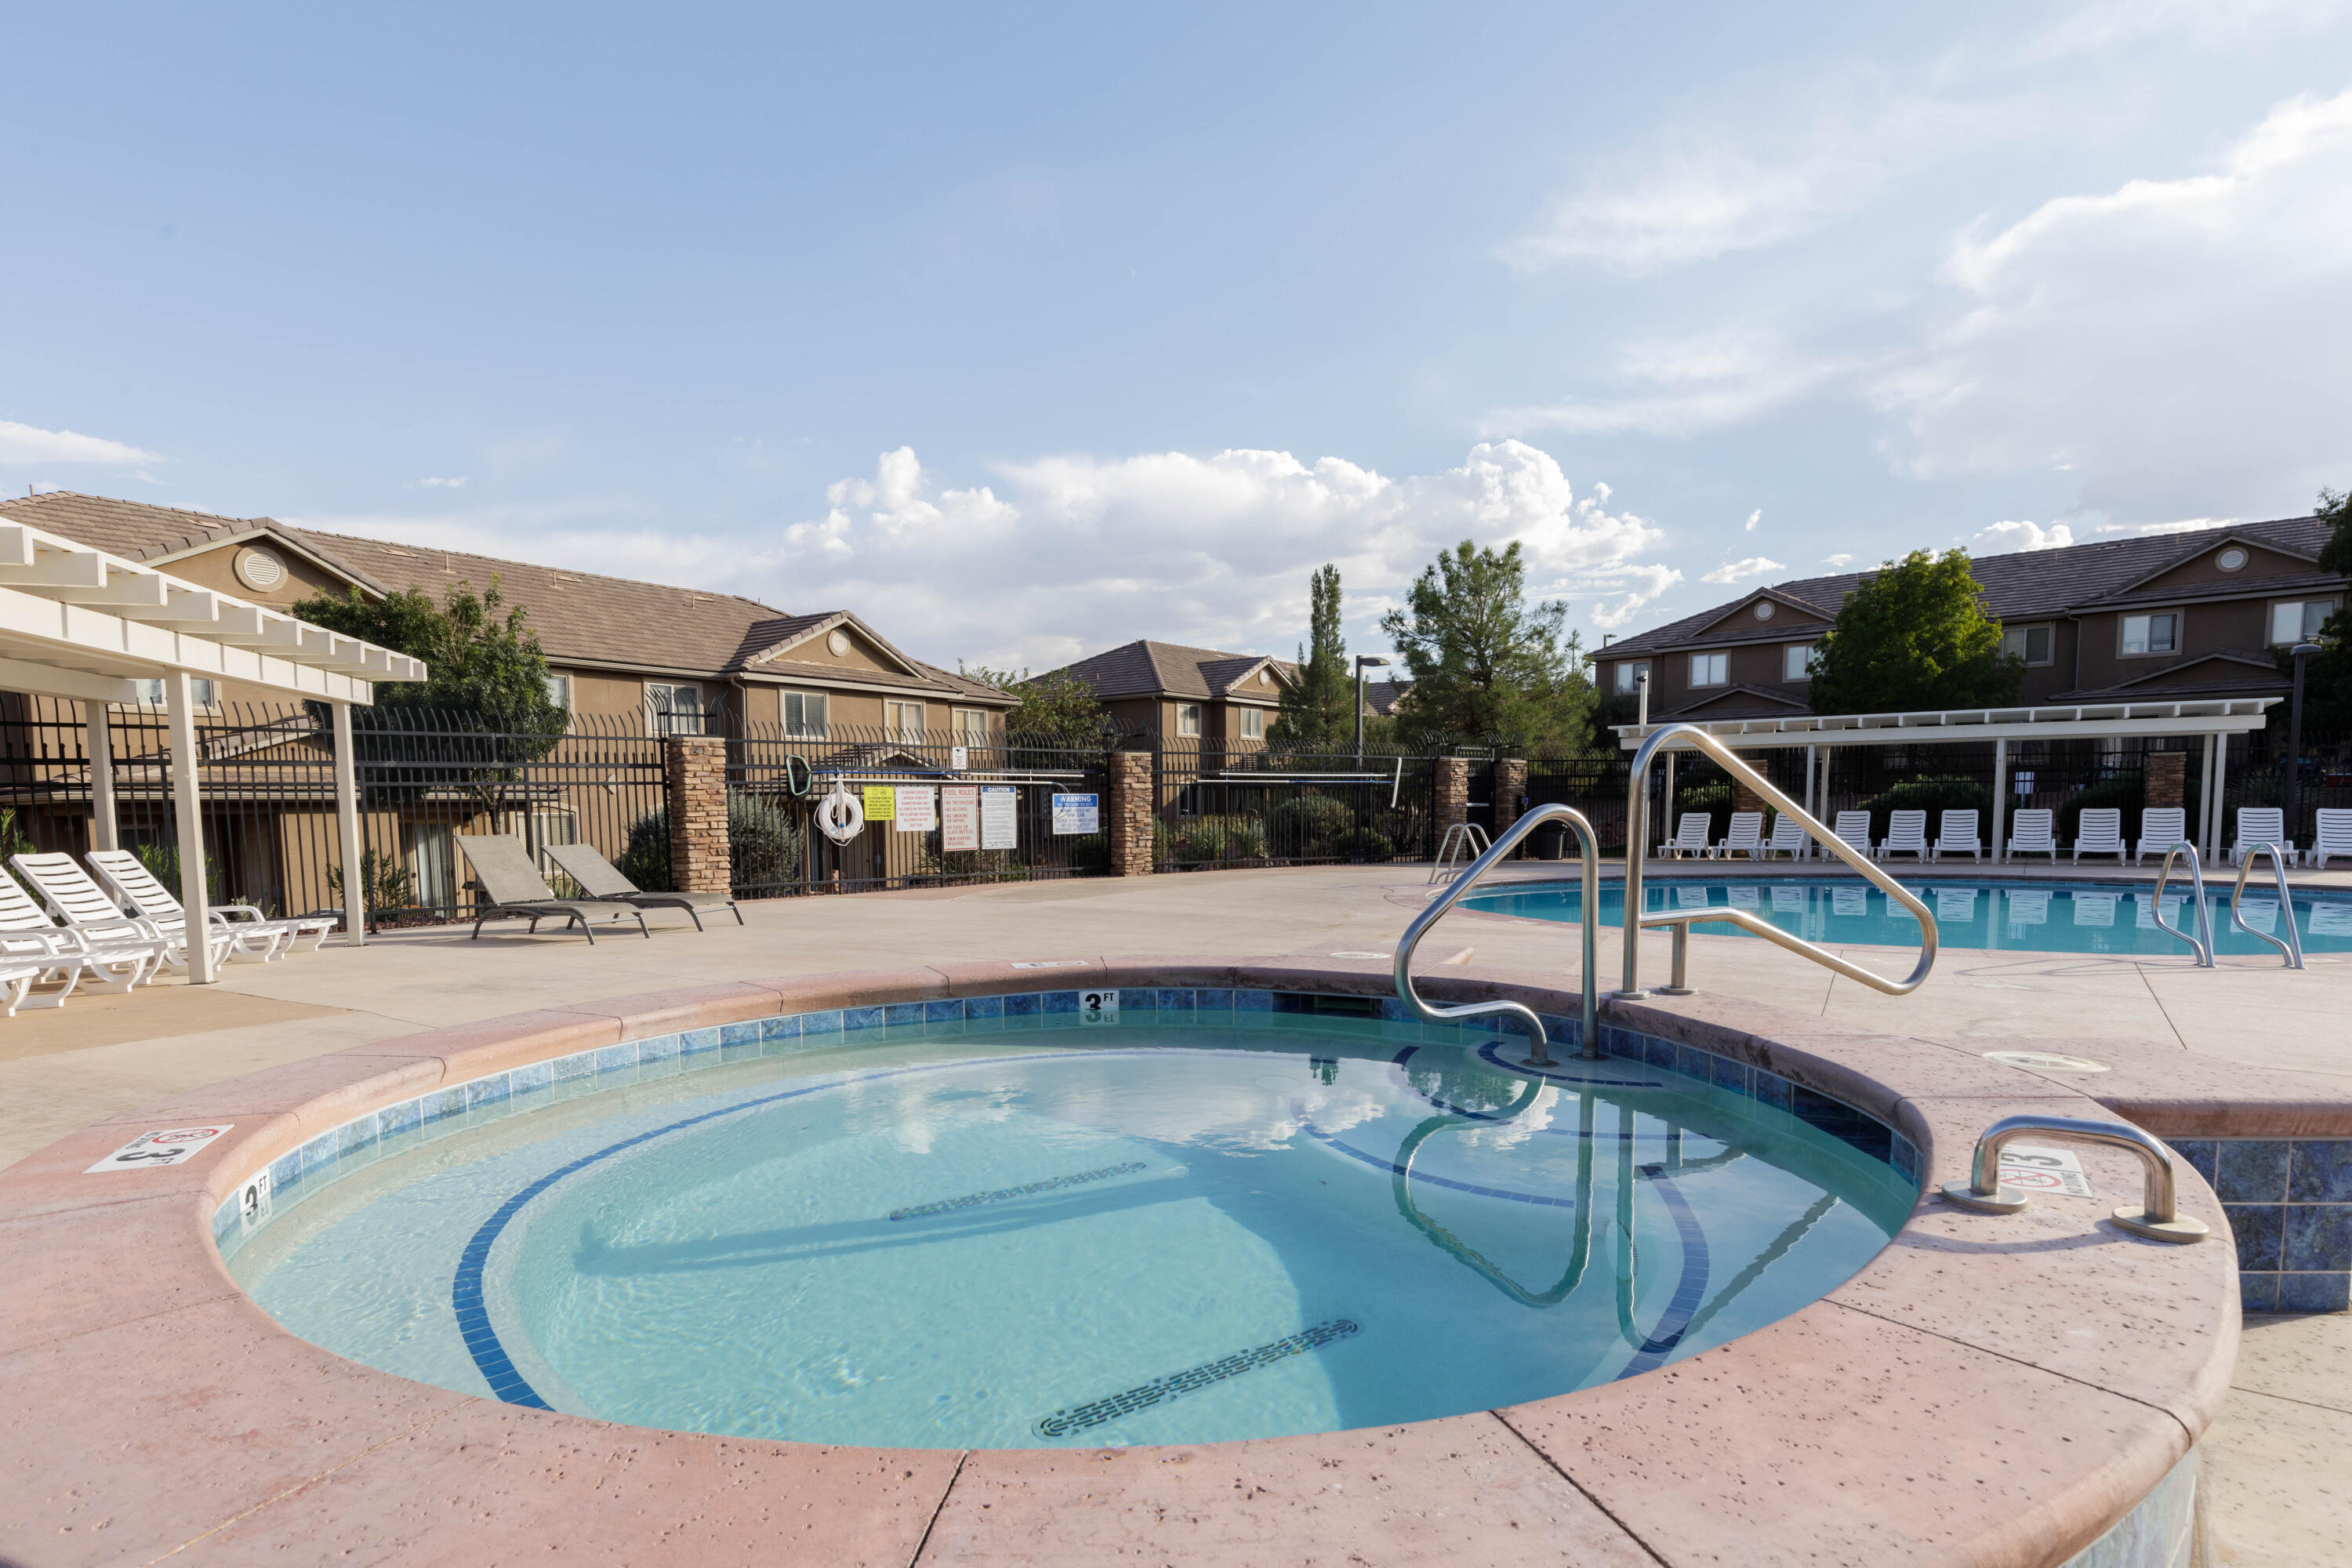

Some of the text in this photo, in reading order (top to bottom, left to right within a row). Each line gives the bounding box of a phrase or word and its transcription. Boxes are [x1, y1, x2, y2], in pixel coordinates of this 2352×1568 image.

[1085, 993, 1102, 1011] 3
[245, 1175, 267, 1216] 3 FT
